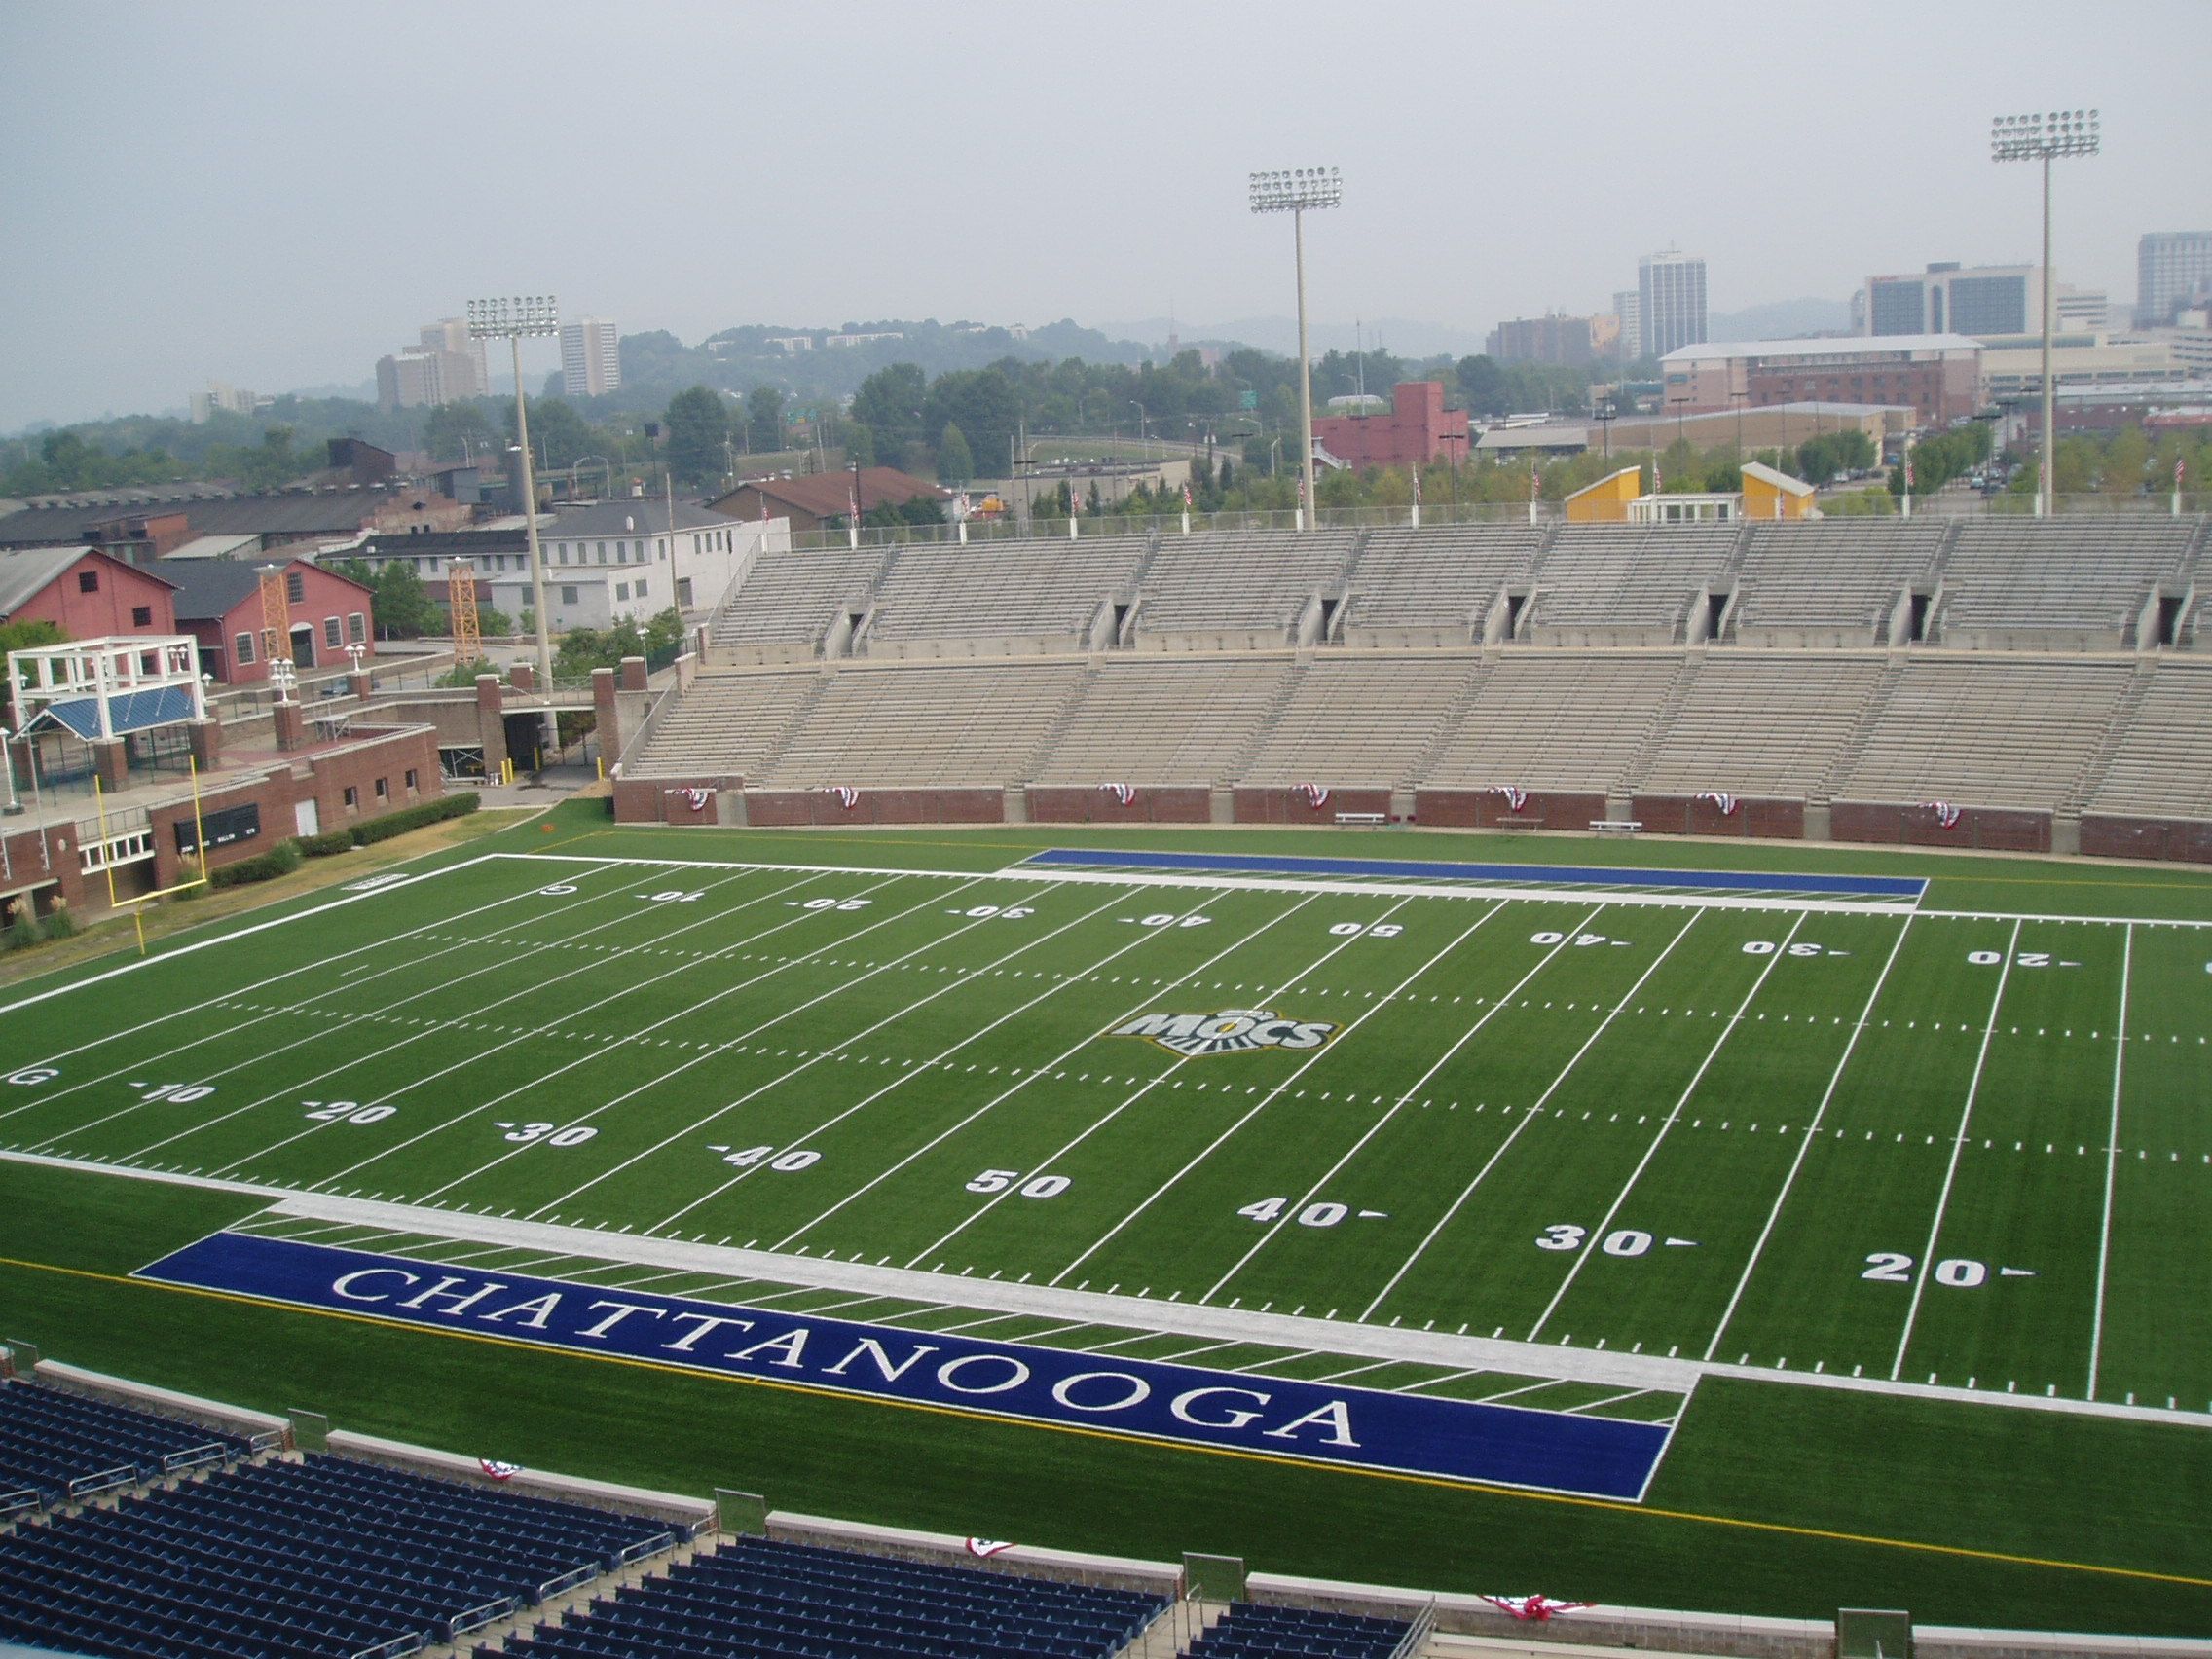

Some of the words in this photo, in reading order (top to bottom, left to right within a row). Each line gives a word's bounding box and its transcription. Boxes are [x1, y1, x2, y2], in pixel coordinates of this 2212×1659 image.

[539, 885, 578, 895] G
[803, 898, 873, 910] 20
[965, 905, 1035, 919] 30
[1140, 914, 1212, 927] 40
[1329, 922, 1404, 937] 50
[1530, 932, 1606, 946] 40
[1742, 941, 1822, 956] 30
[1967, 951, 2050, 967] 20
[1103, 1009, 1344, 1056] MOCS
[8, 1068, 60, 1086] G
[141, 1084, 216, 1102] 10
[305, 1101, 397, 1124] 20
[504, 1123, 598, 1146] 30
[723, 1146, 822, 1171] 40
[965, 1169, 1072, 1198] 50
[1236, 1198, 1348, 1227] 40
[1535, 1225, 1653, 1256] 30
[1861, 1252, 1986, 1286] 20
[330, 1266, 1362, 1449] CHATTANOOGA
